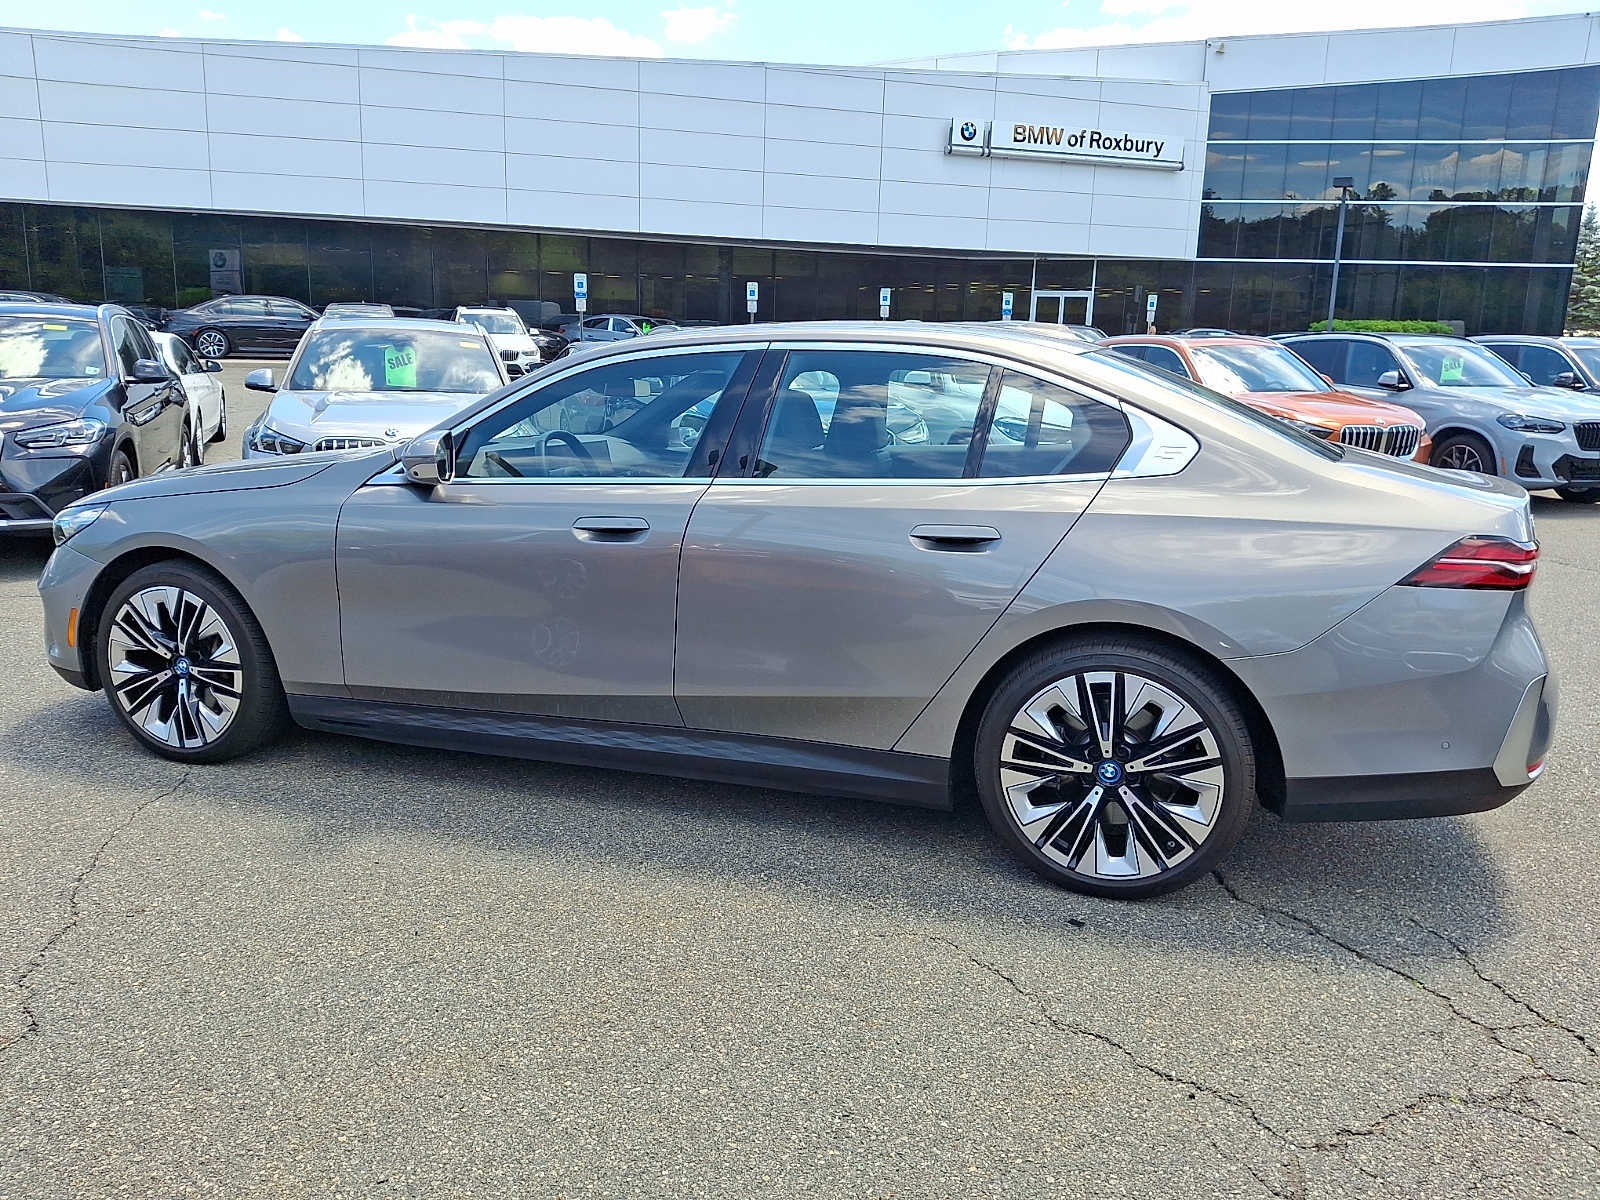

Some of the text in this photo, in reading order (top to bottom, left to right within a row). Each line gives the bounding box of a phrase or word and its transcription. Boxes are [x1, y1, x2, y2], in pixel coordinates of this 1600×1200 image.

[1013, 124, 1164, 158] BMW of Roxbury
[387, 353, 413, 370] SALE
